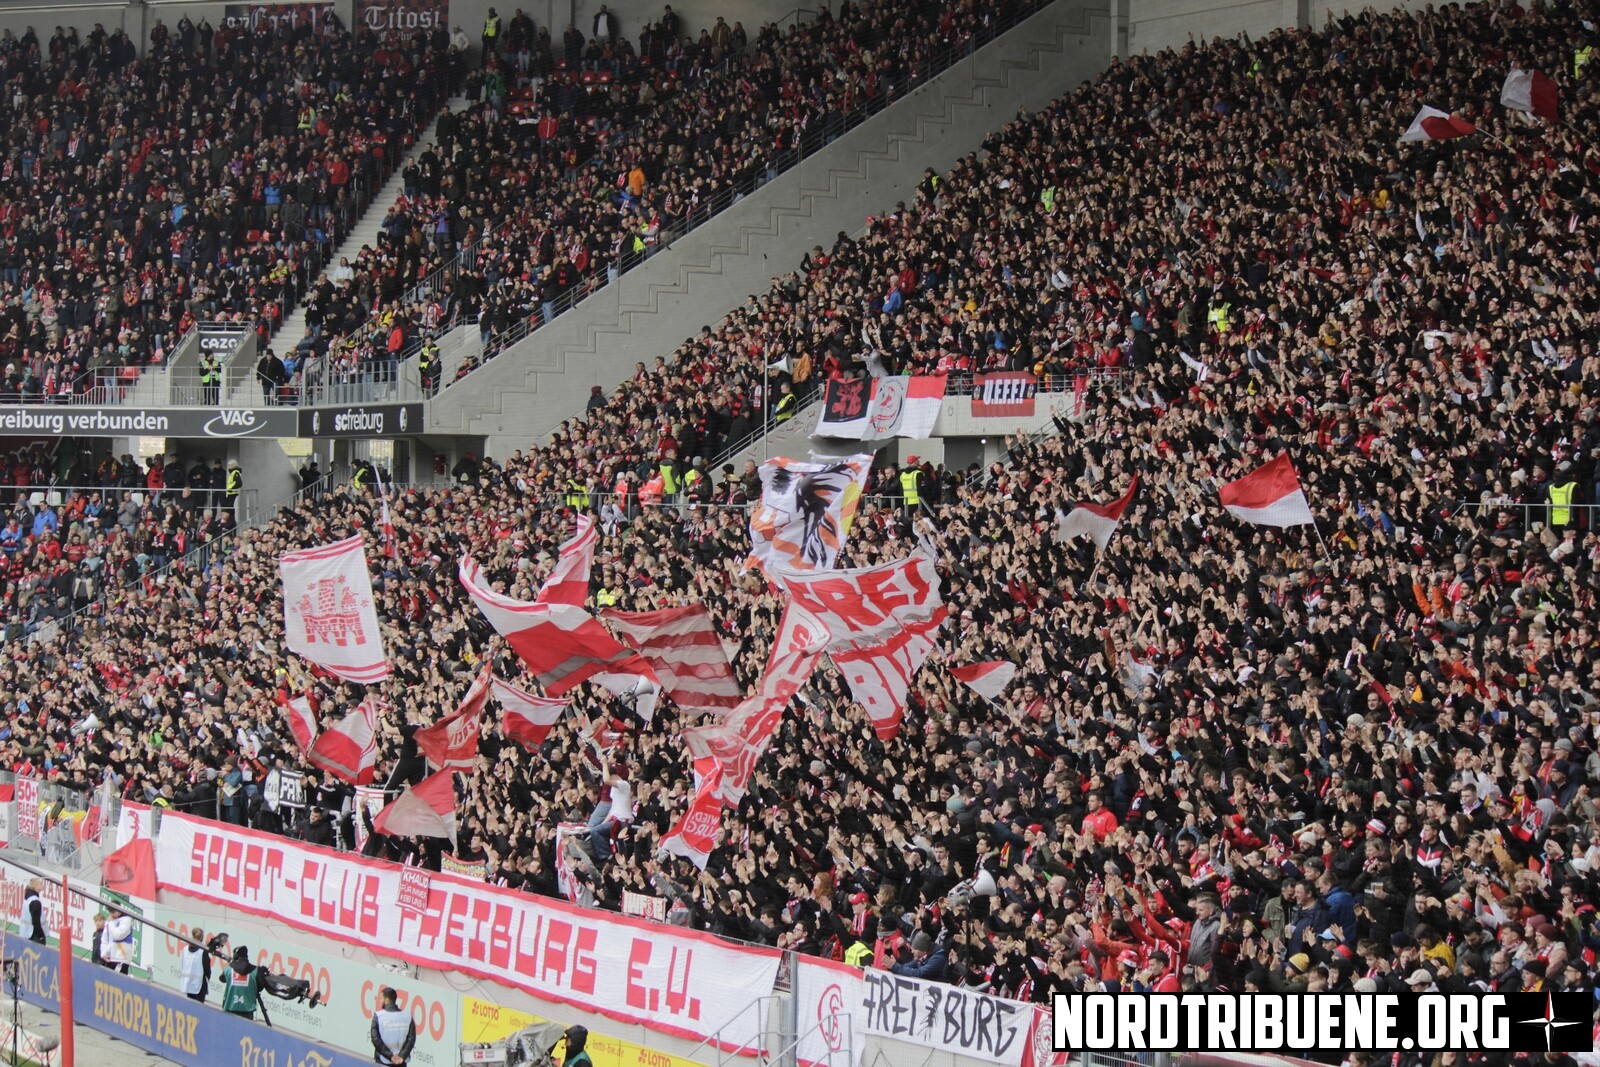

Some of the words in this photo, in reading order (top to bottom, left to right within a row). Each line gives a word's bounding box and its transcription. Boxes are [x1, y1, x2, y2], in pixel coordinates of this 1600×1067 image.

[364, 5, 442, 31] Tifosi
[68, 409, 168, 431] verbunden
[220, 409, 255, 426] VAG
[335, 411, 384, 434] scfreiburg
[42, 879, 86, 910] TANEN
[190, 830, 380, 937] SPORT-CLUB
[42, 904, 84, 942] ZÄPLE
[94, 979, 152, 1037] EUROPA
[155, 1003, 199, 1055] PARK
[479, 1005, 499, 1022] LOTTO
[862, 973, 920, 1036] FREI
[942, 990, 1018, 1058] BURG
[592, 1038, 625, 1058] lotto-bw.de
[647, 1053, 671, 1067] LOTTO
